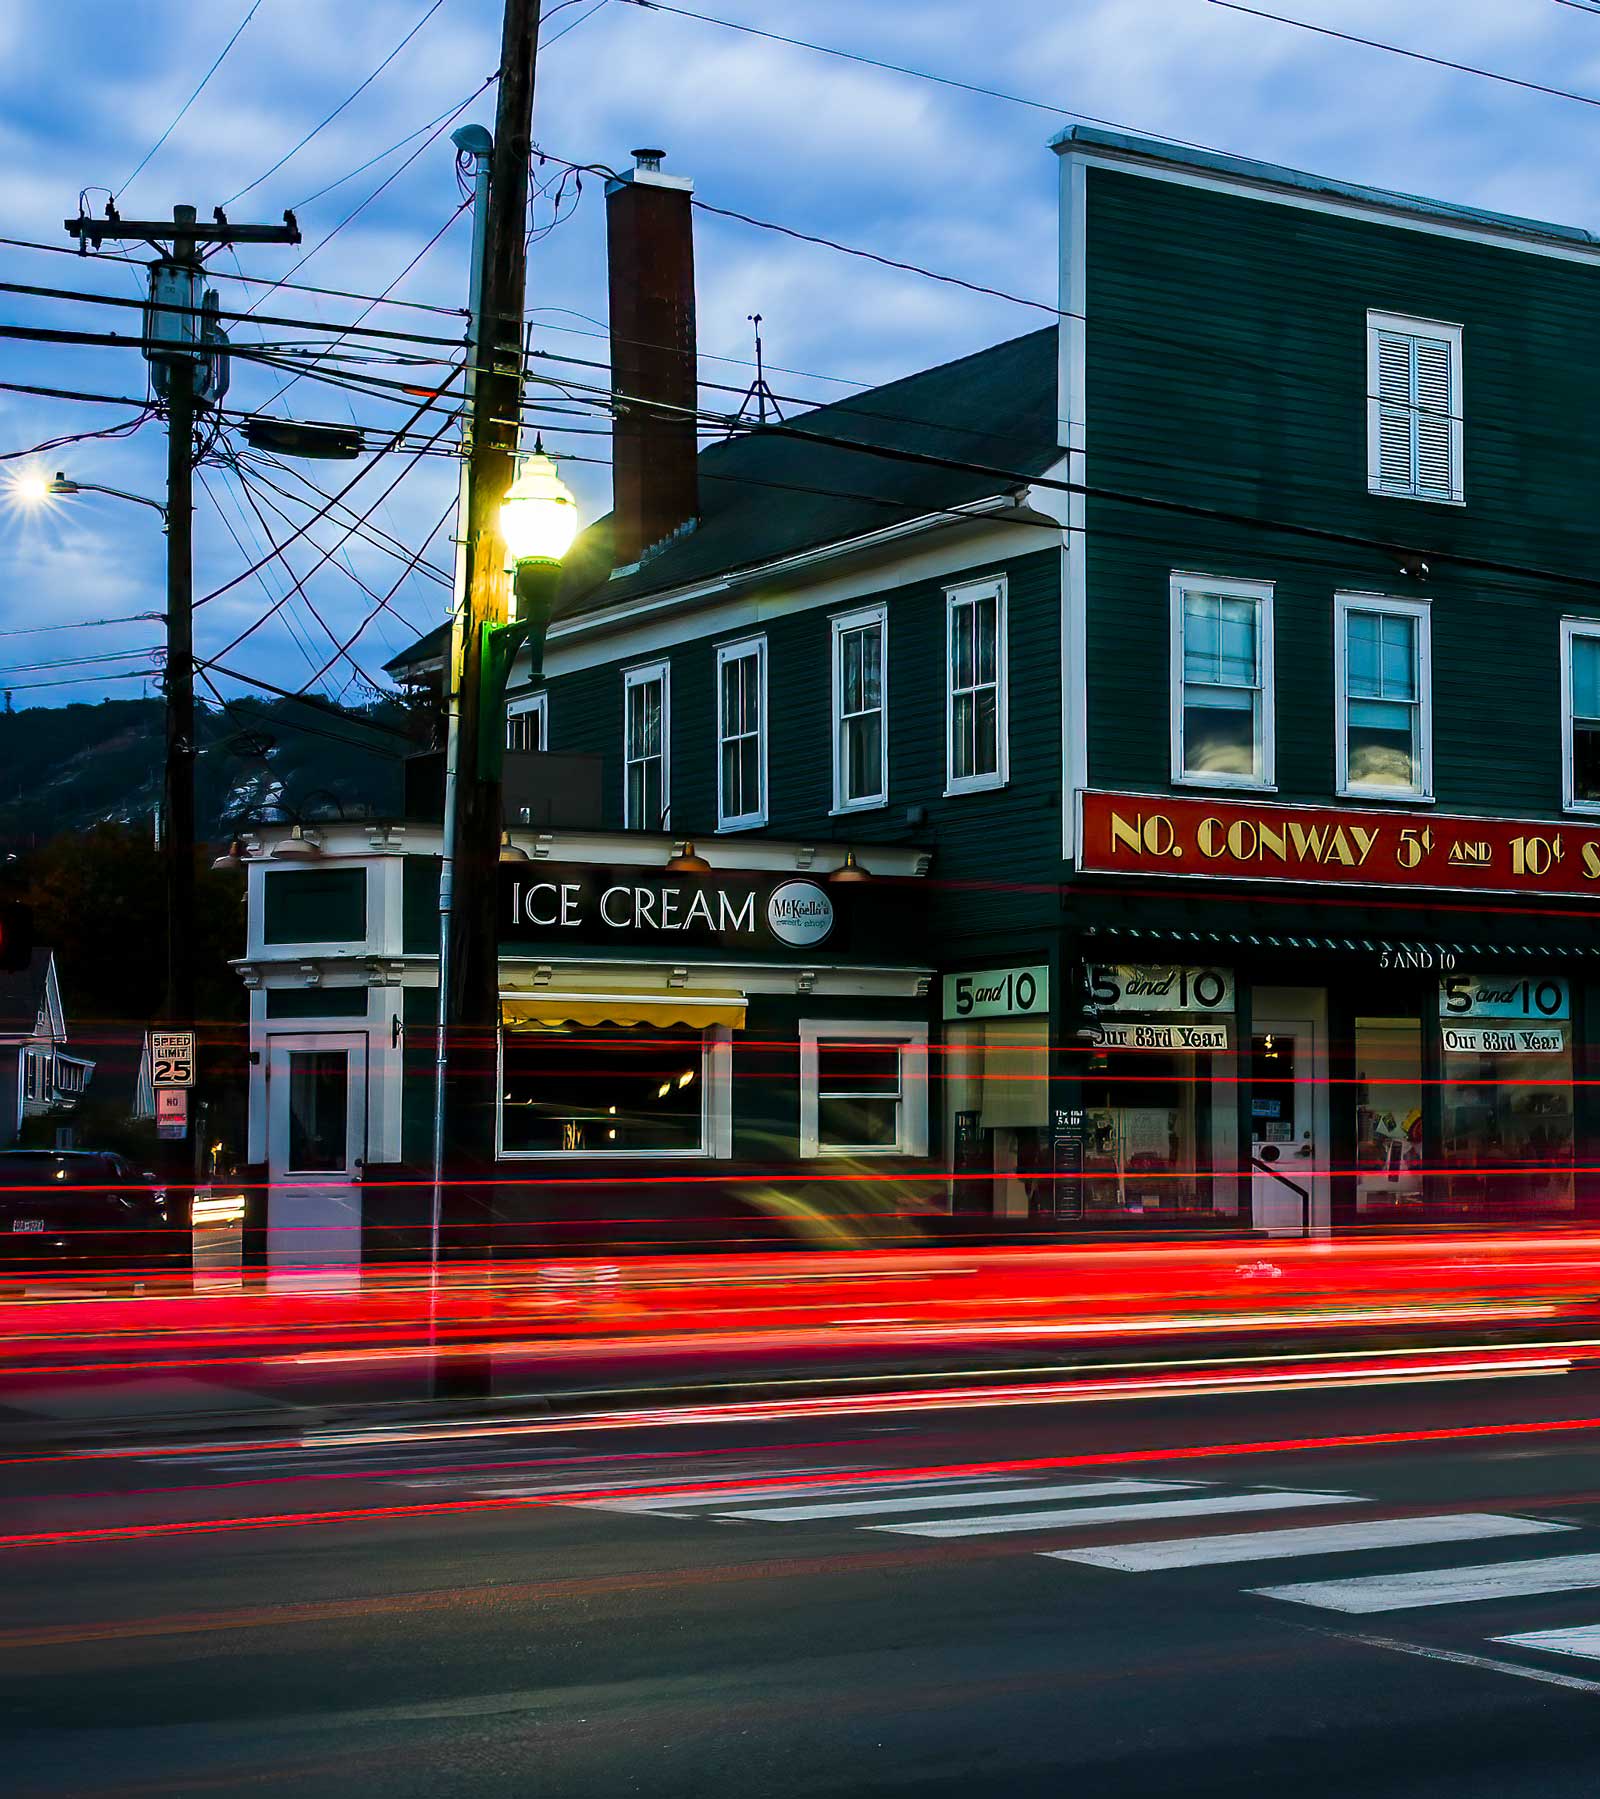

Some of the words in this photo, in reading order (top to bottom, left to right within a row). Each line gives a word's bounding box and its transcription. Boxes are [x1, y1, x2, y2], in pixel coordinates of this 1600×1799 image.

[1111, 811, 1183, 857] NO.
[1197, 817, 1380, 866] CONWAY
[1448, 840, 1492, 867] AND
[512, 882, 583, 926] ICE
[600, 886, 756, 932] CREAM
[1380, 952, 1389, 968] 5
[1393, 952, 1433, 968] AND
[1440, 953, 1456, 969] 10
[956, 978, 974, 1016] 5
[974, 978, 1006, 1003] and
[1006, 972, 1037, 1012] 10
[1092, 969, 1121, 1005] 5
[1126, 969, 1177, 996] and
[1180, 971, 1226, 1007] 10
[1446, 978, 1473, 1013] 5
[1476, 983, 1521, 1003] and
[1523, 980, 1563, 1016] 10
[154, 1037, 191, 1046] SPEED
[1135, 1027, 1172, 1047] 83rd
[1178, 1028, 1224, 1047] Year
[1445, 1031, 1476, 1049] Our
[1483, 1032, 1517, 1050] 83rd
[1520, 1032, 1560, 1050] Year
[157, 1048, 188, 1058] LIMIT
[154, 1061, 191, 1082] 25
[166, 1098, 179, 1107] NO
